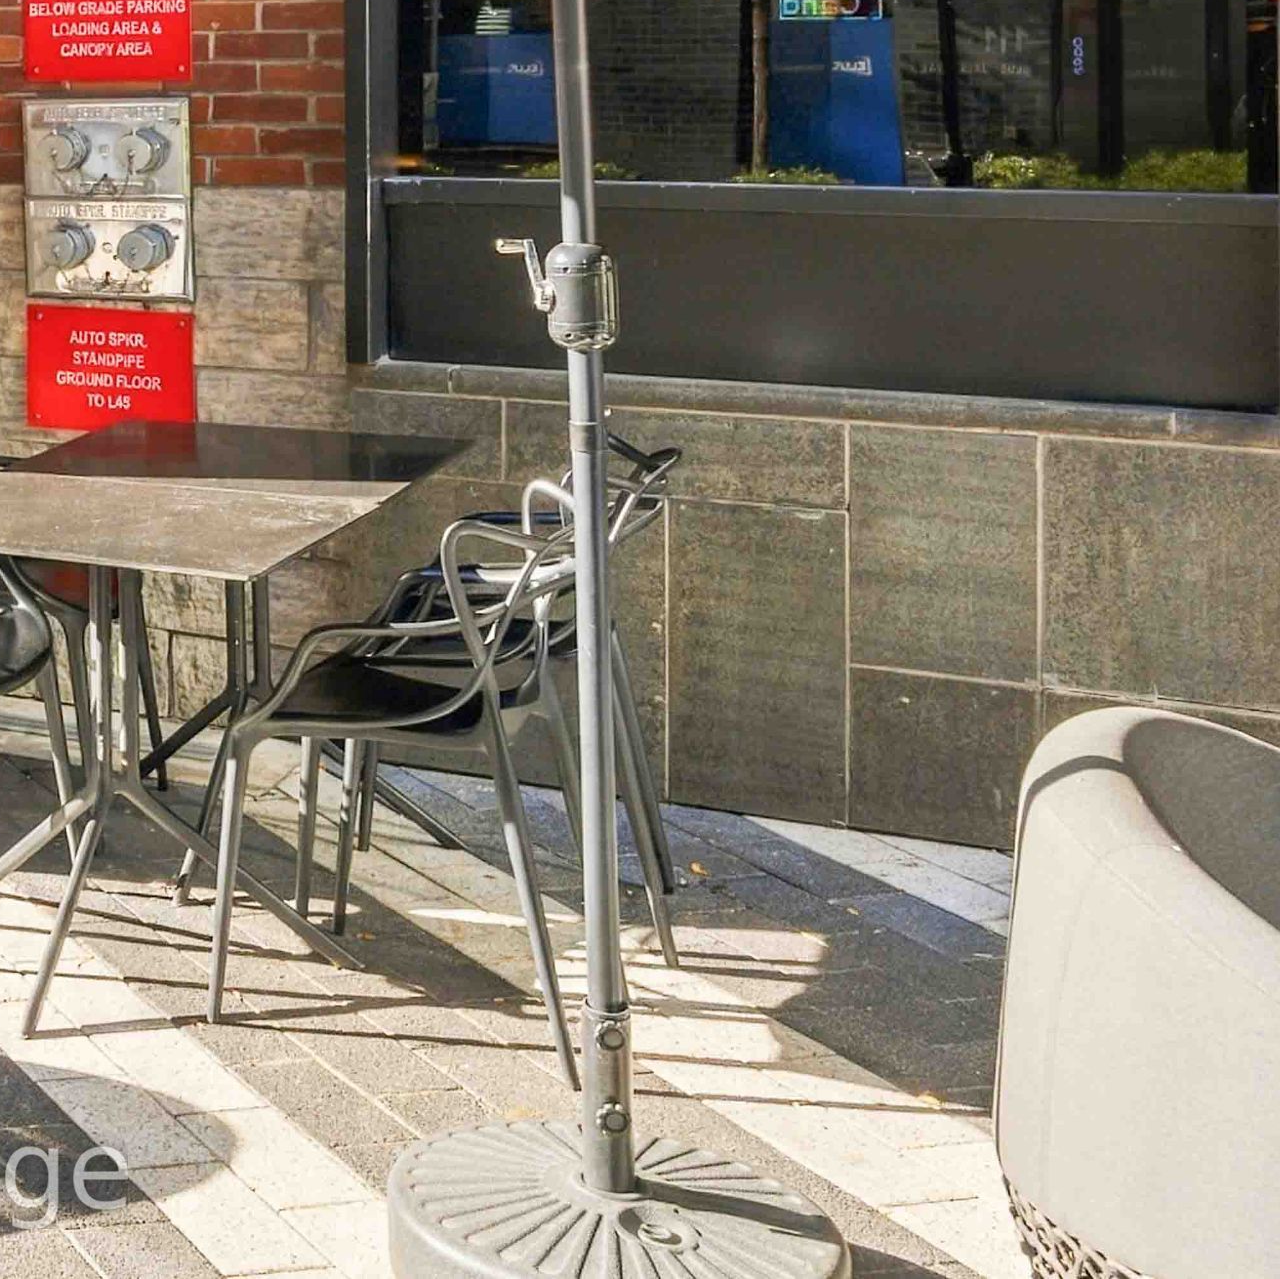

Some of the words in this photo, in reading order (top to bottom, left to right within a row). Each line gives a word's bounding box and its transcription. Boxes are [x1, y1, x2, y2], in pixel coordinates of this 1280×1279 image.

[29, 2, 75, 17] BELOW
[78, 0, 123, 16] GRADE
[52, 21, 109, 37] LOADING
[112, 21, 149, 36] AREA
[151, 21, 162, 35] &
[60, 42, 114, 58] CANOPY
[116, 42, 153, 56] AREA
[70, 330, 105, 345] AUTO
[73, 350, 145, 369] STANDPIPE
[56, 370, 113, 388] GROUND
[116, 375, 162, 391] FLOOR
[86, 393, 105, 408] TO
[108, 395, 131, 410] L45
